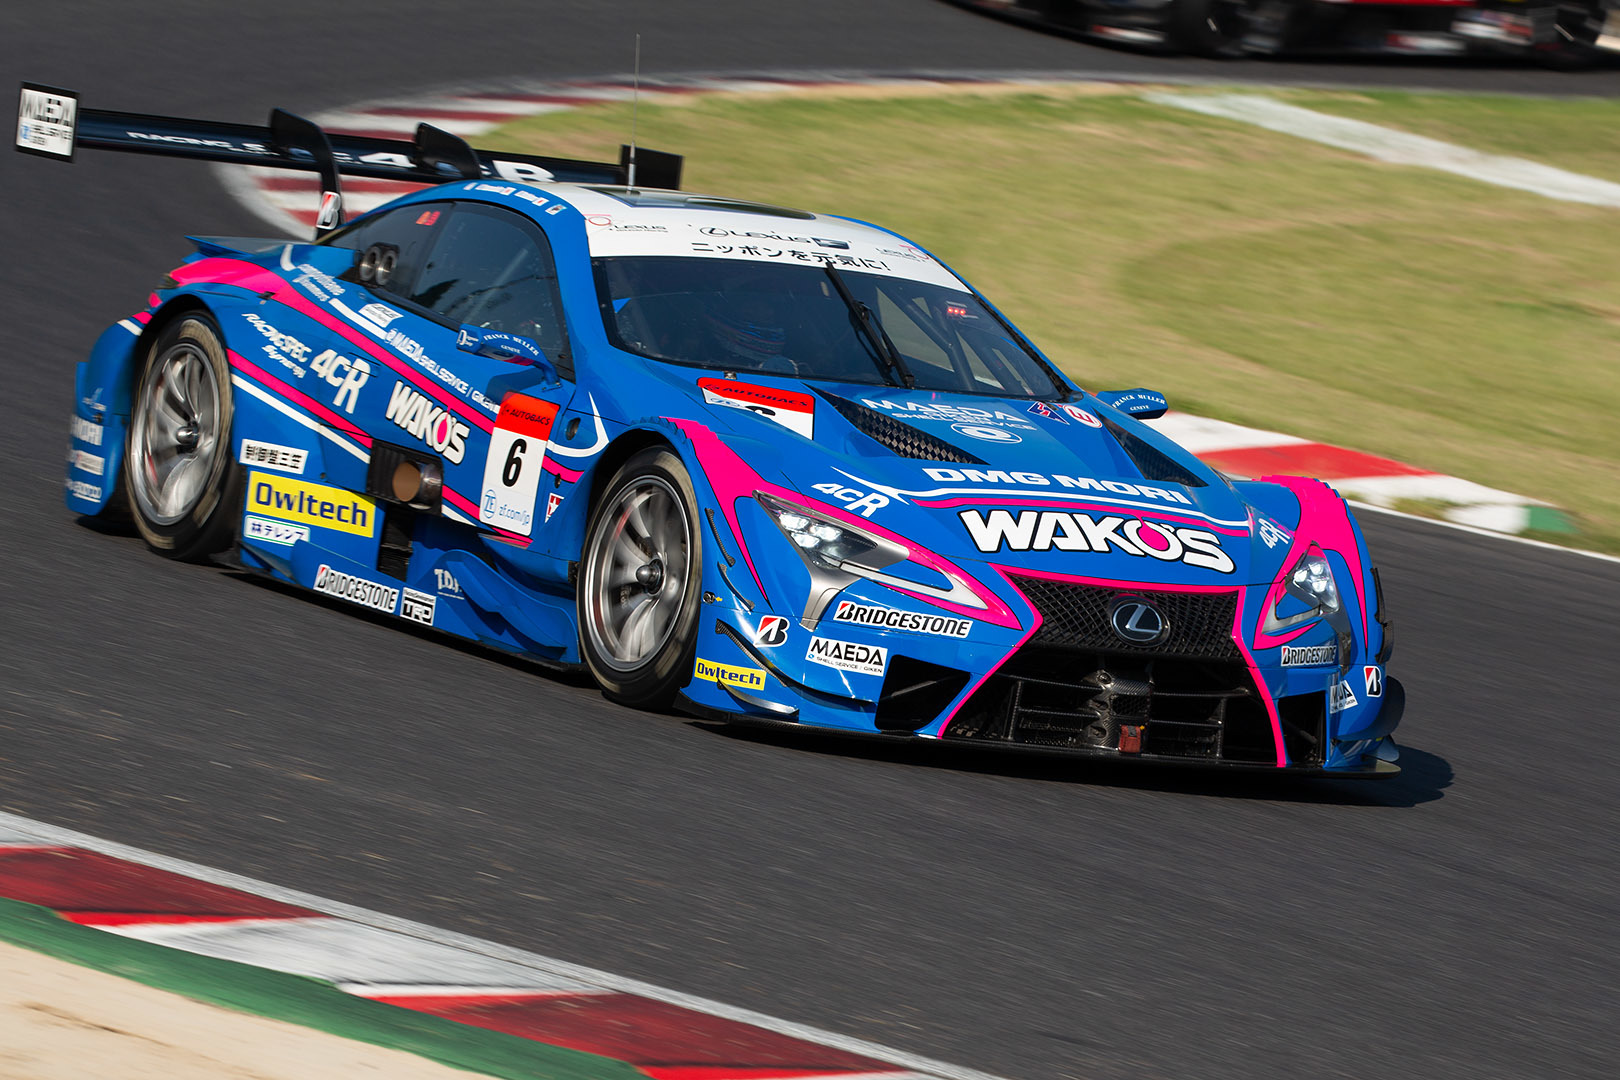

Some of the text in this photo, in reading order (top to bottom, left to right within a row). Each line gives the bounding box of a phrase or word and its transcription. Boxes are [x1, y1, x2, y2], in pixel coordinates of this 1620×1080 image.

[730, 229, 812, 244] LEXUS
[484, 334, 510, 342] FRANCK
[512, 335, 540, 357] MULLER
[310, 349, 371, 414] 4CR
[722, 387, 808, 407] AUTOBACS
[1112, 394, 1166, 409] FRANCK MULLER
[510, 408, 551, 426] AUTOBACS
[861, 398, 1030, 424] MAEDA
[502, 438, 527, 487] 6
[921, 467, 1193, 505] DMG MORI
[255, 481, 368, 528] Owltech
[810, 483, 891, 518] 4CR
[316, 565, 397, 611] BRIDGESTONE
[837, 602, 970, 637] BRIDGESTONE
[810, 638, 884, 666] MAEDA
[816, 656, 834, 666] SHELL
[834, 660, 859, 670] SERVICE
[1281, 646, 1337, 665] BRIDGESTONE
[696, 662, 762, 686] Owltech
